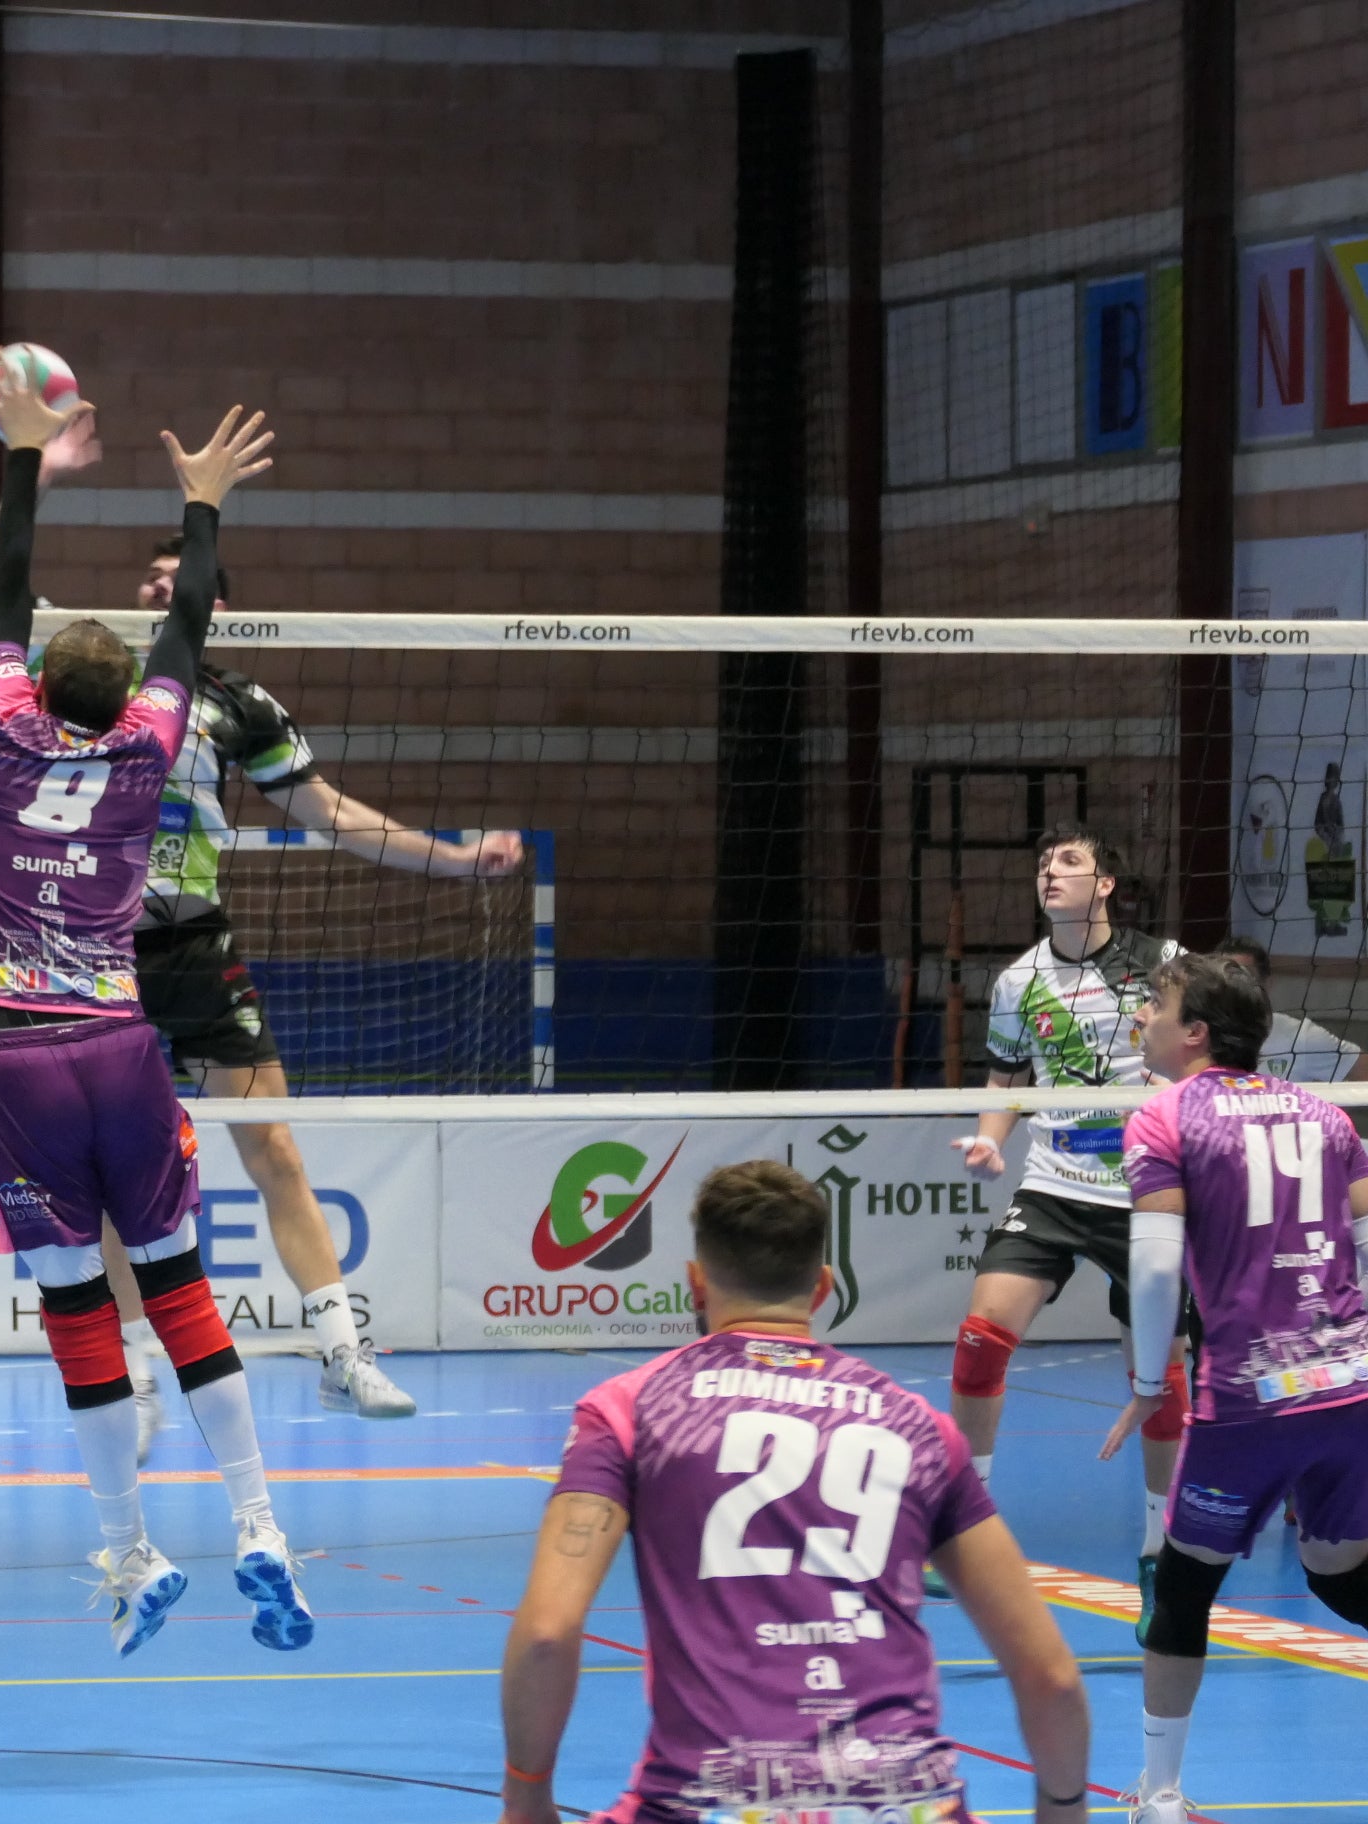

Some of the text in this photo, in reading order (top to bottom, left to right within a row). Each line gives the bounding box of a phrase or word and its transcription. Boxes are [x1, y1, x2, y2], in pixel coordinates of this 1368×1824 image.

[503, 616, 631, 641] rfevb.com
[849, 621, 975, 645] rfevb.com
[1188, 624, 1311, 645] rfevb.com
[18, 759, 111, 834] 8
[12, 854, 76, 878] suma
[1079, 1016, 1099, 1049] 8
[1242, 1121, 1324, 1228] 14
[867, 1182, 990, 1216] HOTEL
[945, 1255, 982, 1272] BEN
[483, 1283, 620, 1317] GRUPO
[483, 1323, 593, 1338] GASTRONOMÍA
[609, 1323, 648, 1335] OCIO
[691, 1367, 884, 1420] CUMINETTI
[698, 1410, 913, 1584] 29
[755, 1620, 859, 1646] suma
